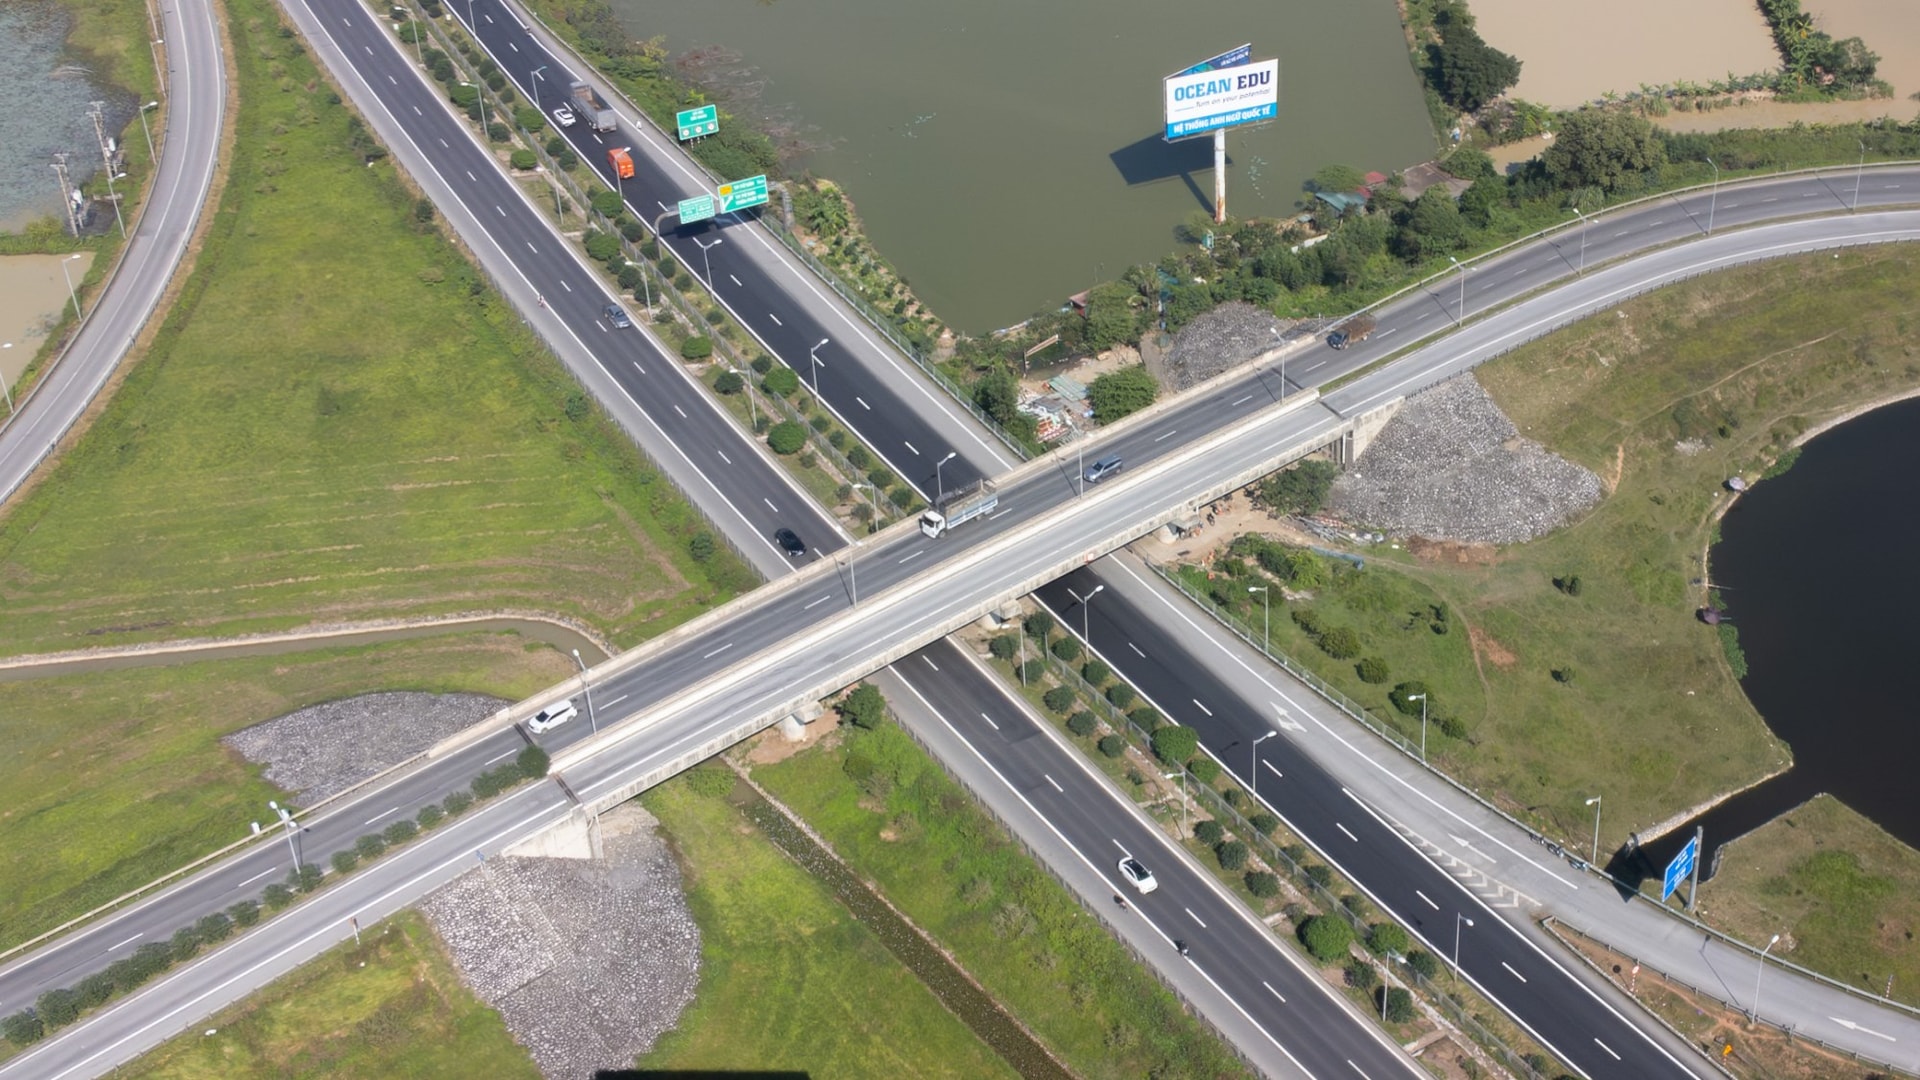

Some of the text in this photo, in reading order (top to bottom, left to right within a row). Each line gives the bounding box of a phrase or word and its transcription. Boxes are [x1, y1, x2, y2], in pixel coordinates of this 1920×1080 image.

[1174, 71, 1271, 101] OCEAN EDU
[1222, 95, 1237, 103] your
[1210, 115, 1225, 127] ANH
